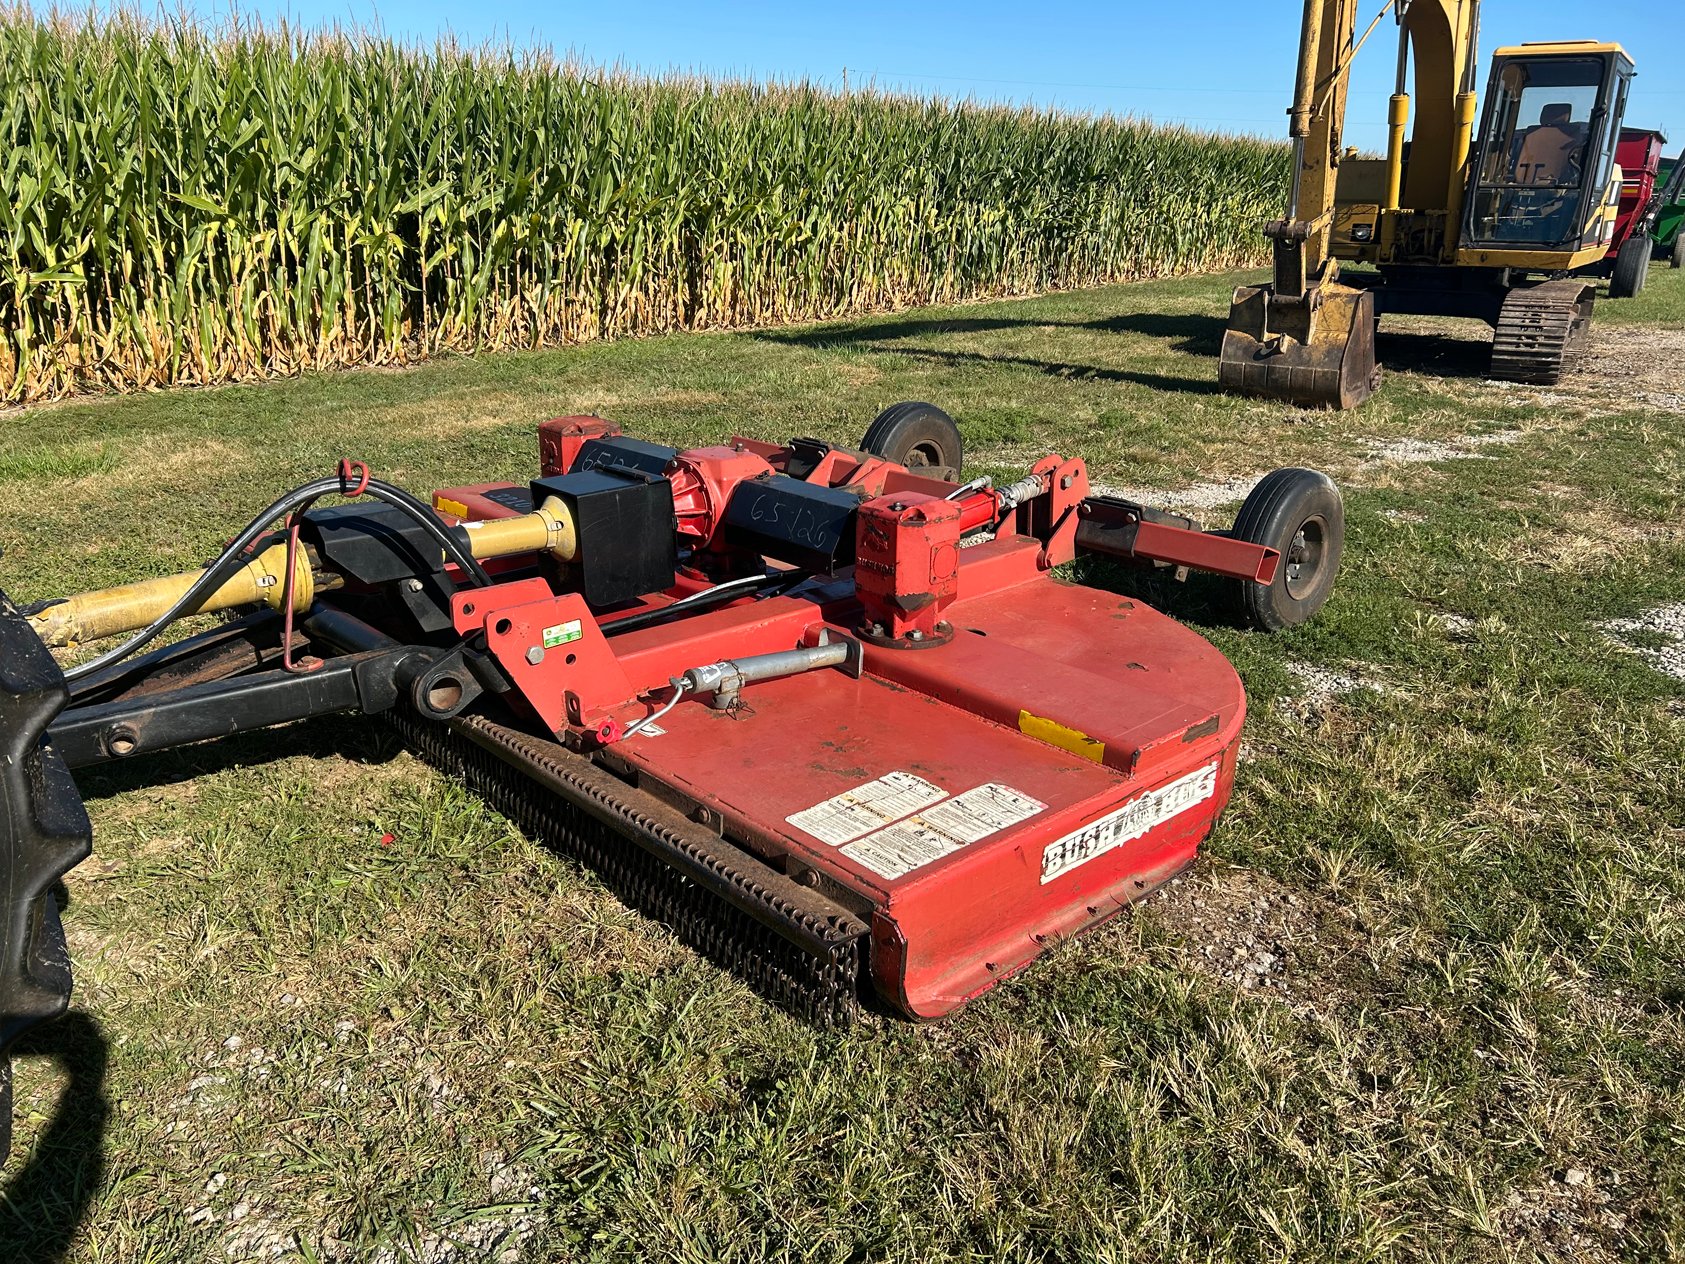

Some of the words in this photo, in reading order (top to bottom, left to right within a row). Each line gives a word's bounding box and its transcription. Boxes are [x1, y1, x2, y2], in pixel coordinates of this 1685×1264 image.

[911, 776, 941, 794] WARNING
[855, 801, 886, 819] WARNING
[872, 851, 899, 867] CAUTION
